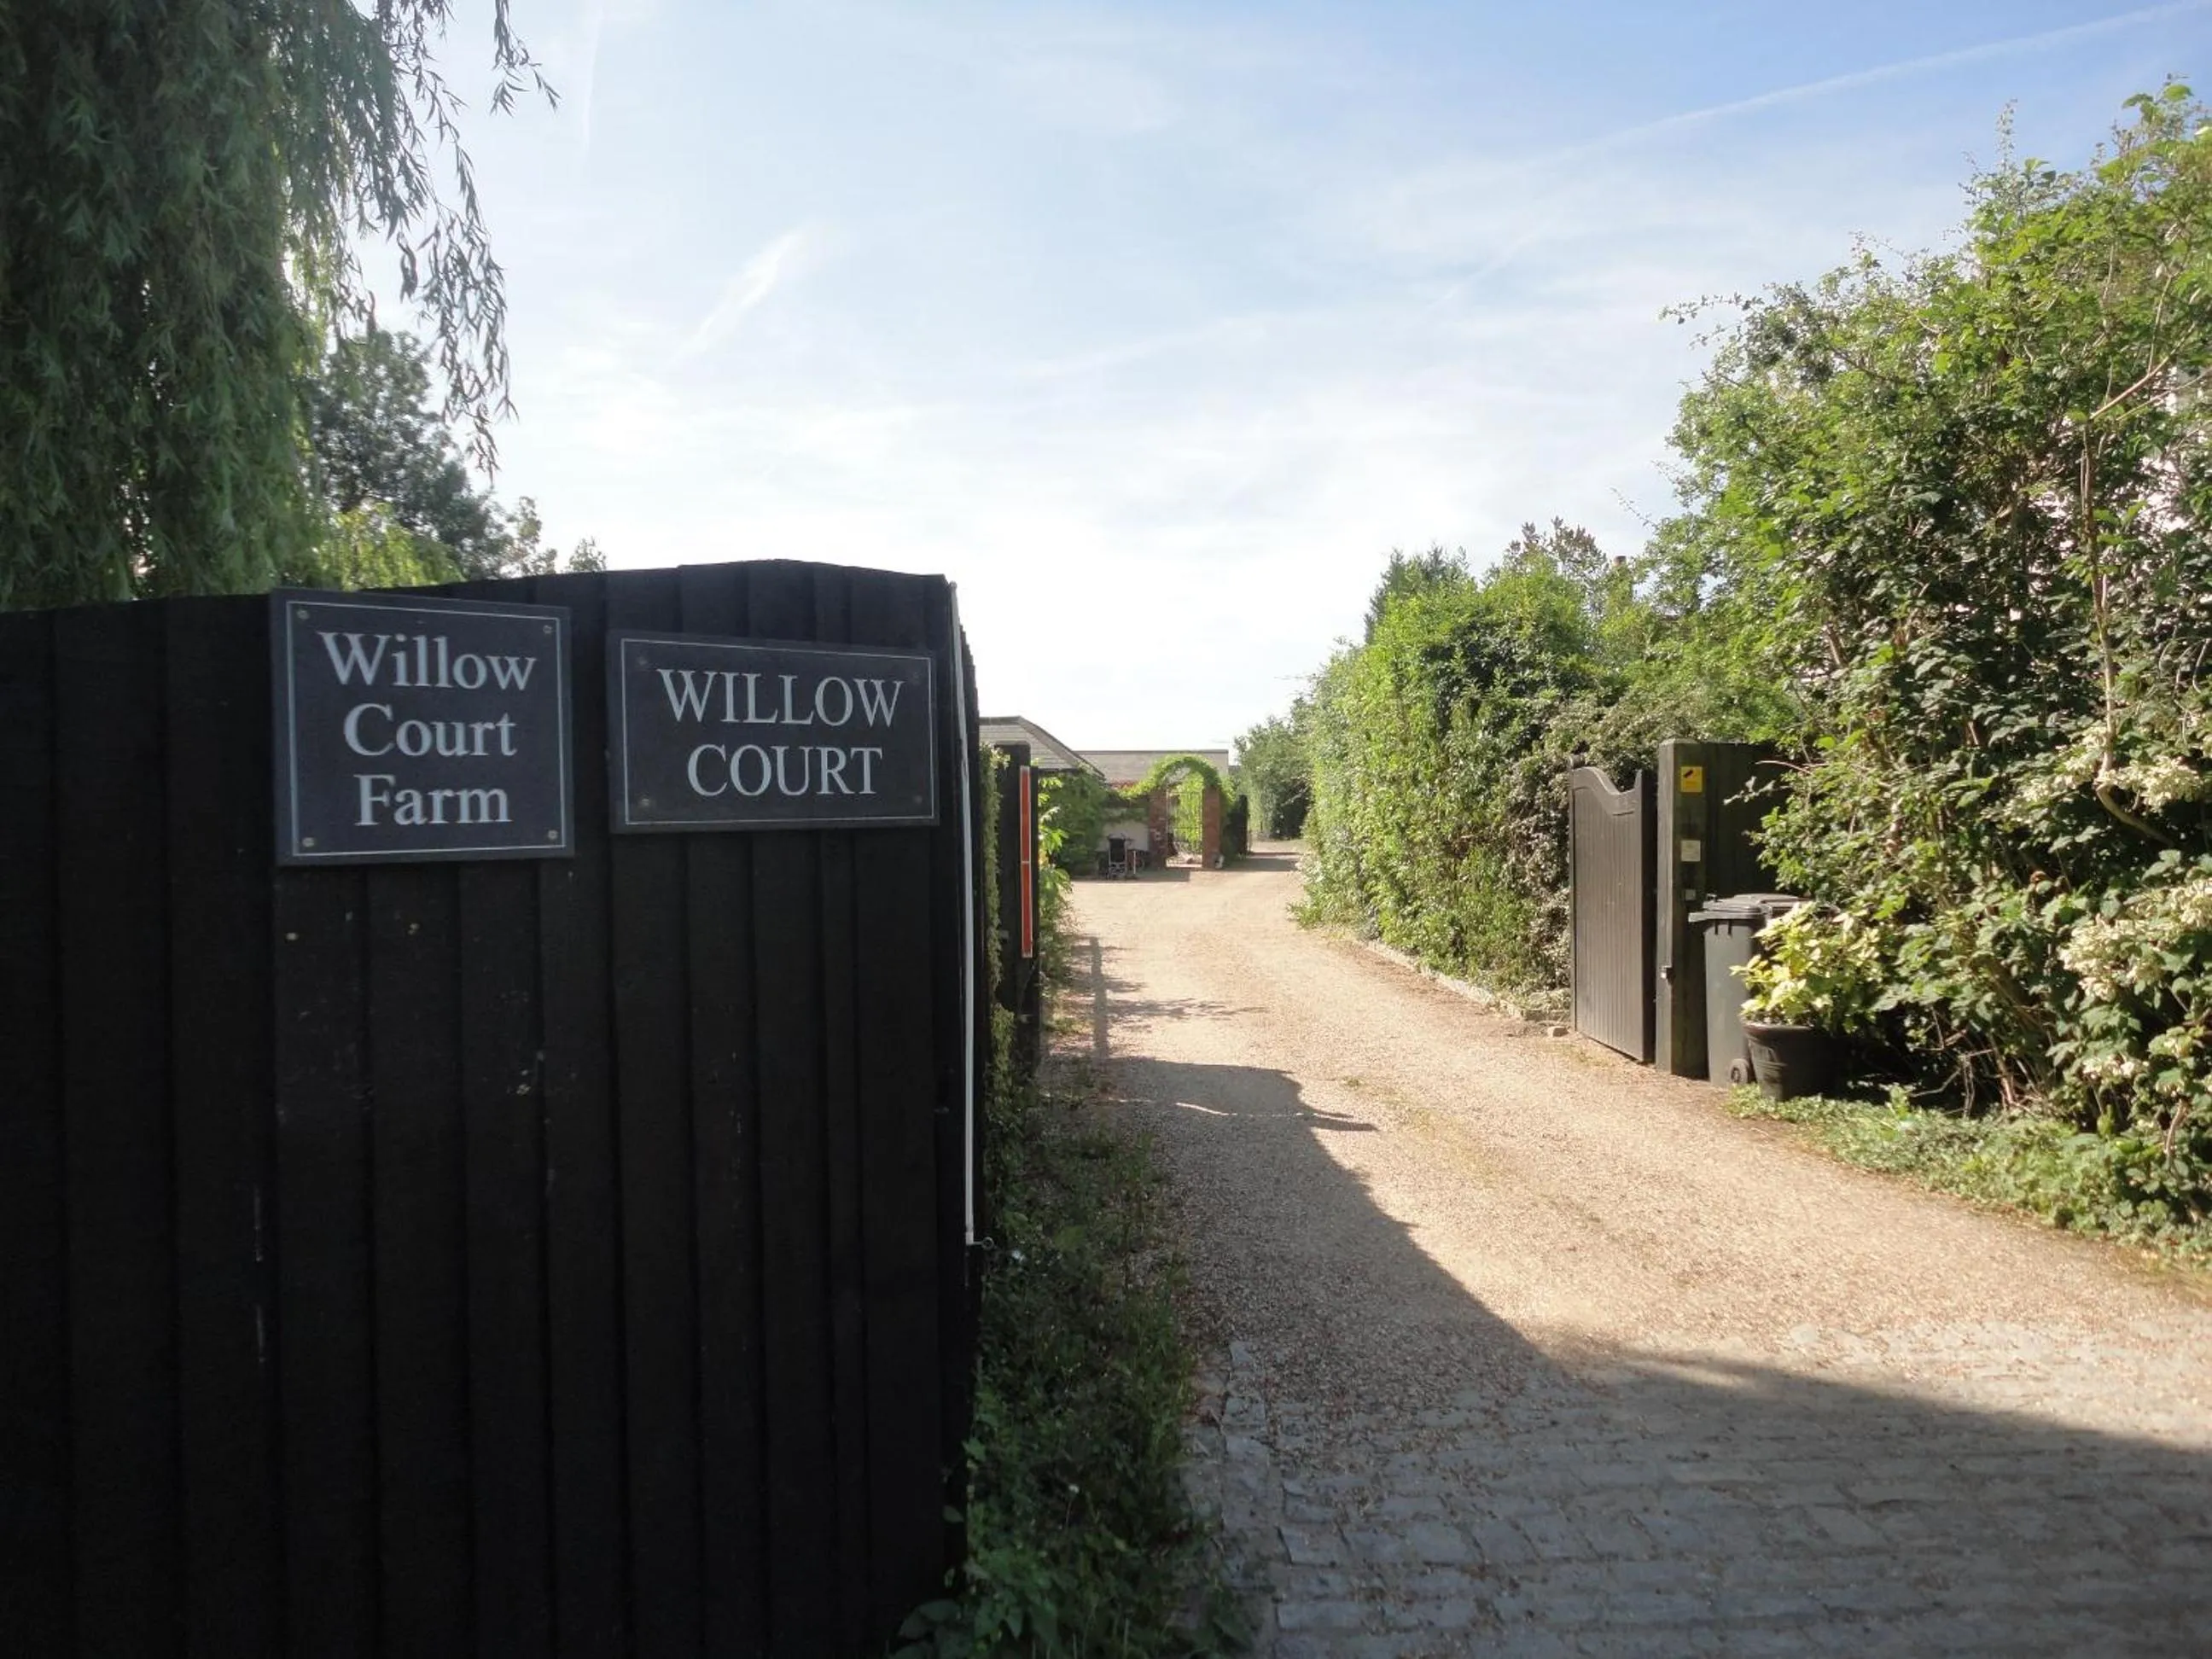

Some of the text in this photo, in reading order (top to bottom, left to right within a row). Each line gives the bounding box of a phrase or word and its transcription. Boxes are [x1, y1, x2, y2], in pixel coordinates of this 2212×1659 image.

[318, 632, 537, 690] Willow
[656, 668, 905, 727] WILLOW
[344, 703, 517, 757] Court
[687, 743, 882, 796] COURT
[353, 774, 513, 826] Farm
